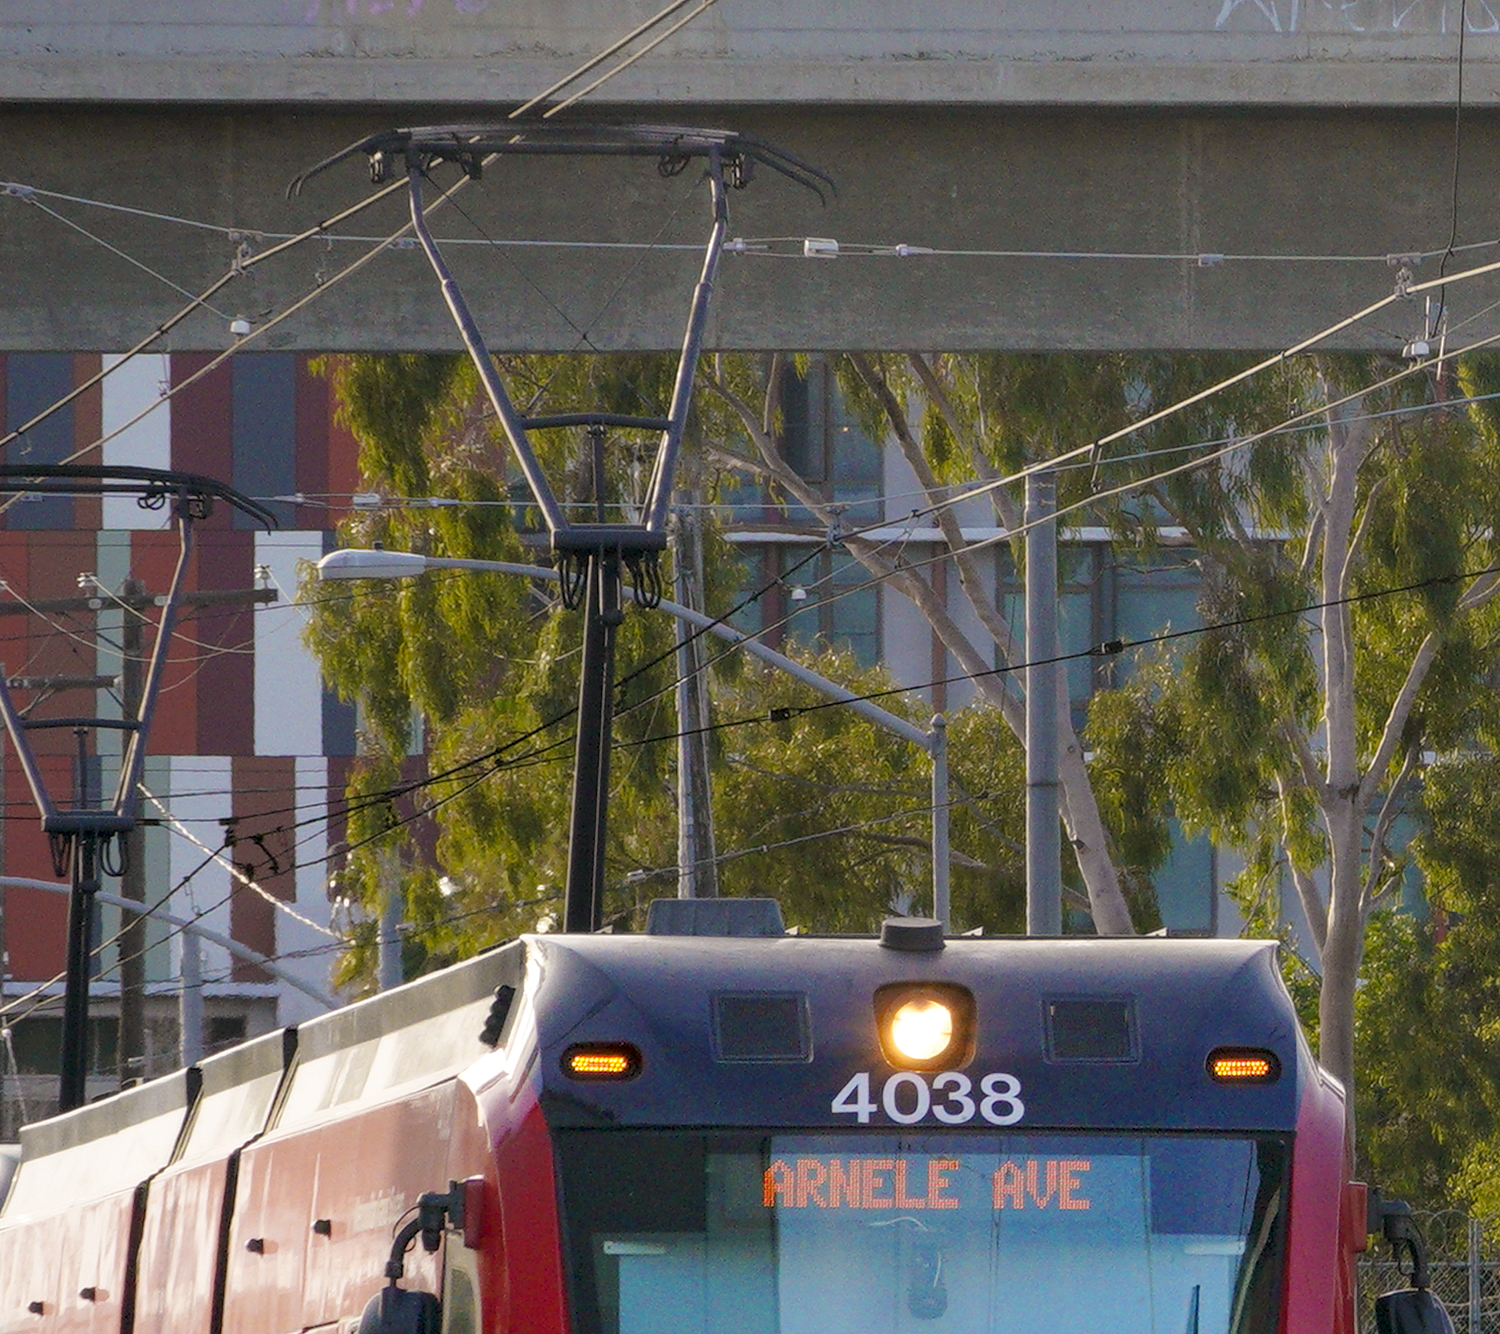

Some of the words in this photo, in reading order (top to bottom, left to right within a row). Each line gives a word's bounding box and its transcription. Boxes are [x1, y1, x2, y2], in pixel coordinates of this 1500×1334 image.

[831, 1071, 1026, 1126] 4038
[763, 1158, 960, 1209] ARNELE
[992, 1159, 1092, 1210] AVE
